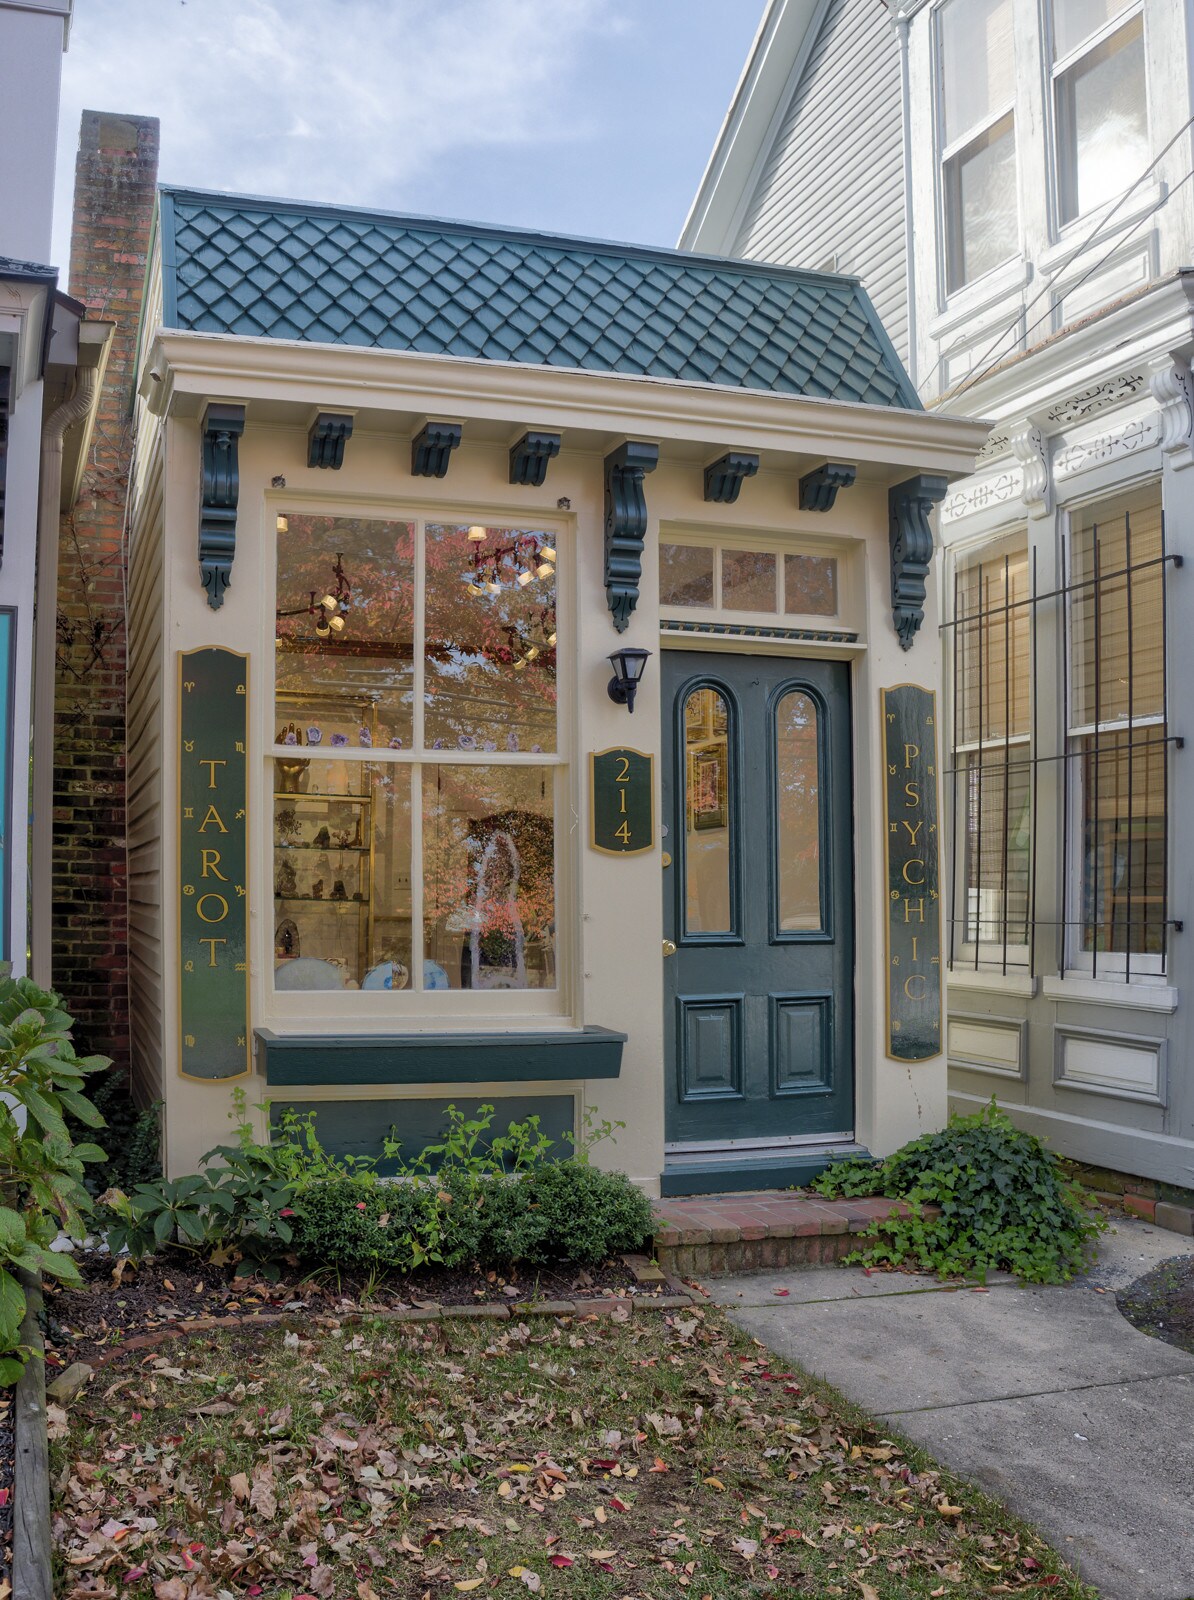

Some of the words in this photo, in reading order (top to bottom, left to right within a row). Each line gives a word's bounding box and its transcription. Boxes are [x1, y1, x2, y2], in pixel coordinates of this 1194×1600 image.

[196, 760, 229, 968] TAROT
[614, 757, 632, 844] 214
[902, 743, 926, 1001] PSYCHIC
